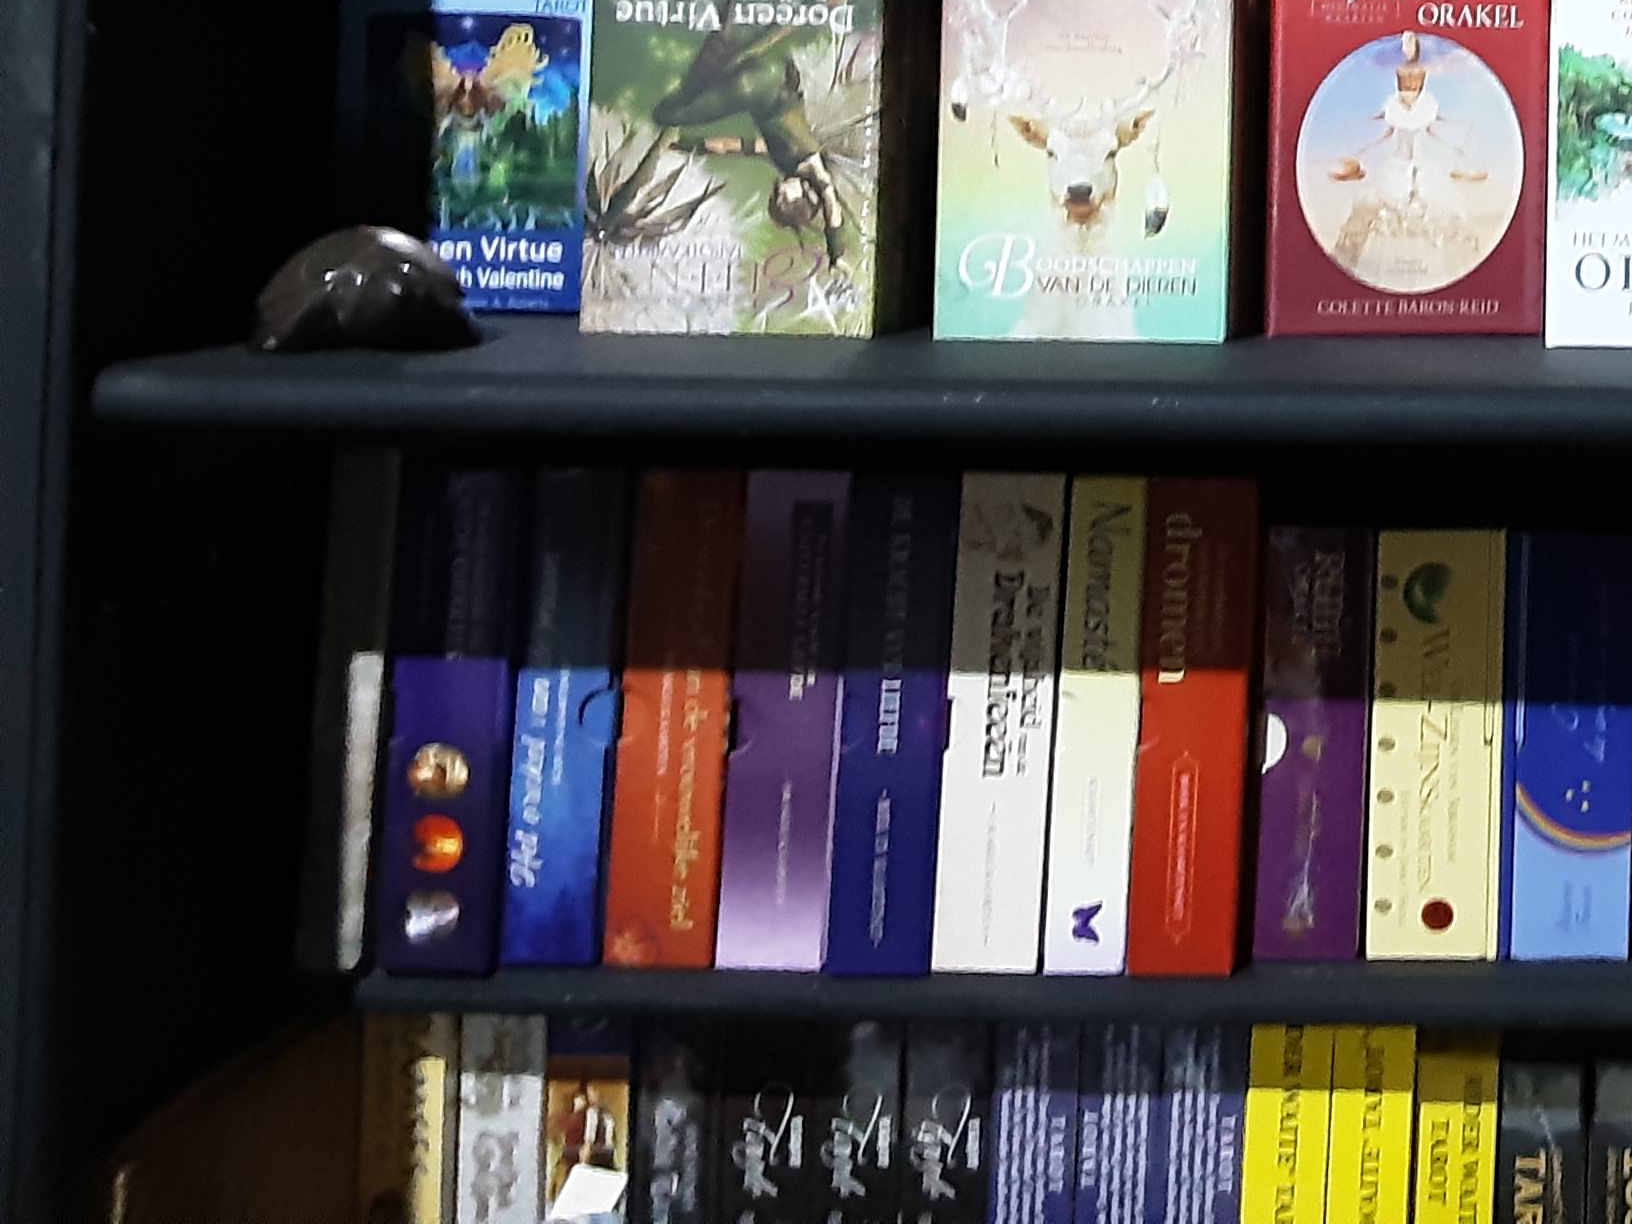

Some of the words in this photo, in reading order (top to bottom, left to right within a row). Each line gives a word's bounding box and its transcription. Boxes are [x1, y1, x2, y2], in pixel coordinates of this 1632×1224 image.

[615, 1, 723, 32] Virtue
[737, 2, 856, 34] Doreen
[1417, 2, 1525, 30] ORAKEL
[481, 235, 564, 264] Virtue
[476, 265, 566, 291] Valentine
[1035, 278, 1078, 297] VAN
[1124, 278, 1197, 298] DIEREN
[1316, 299, 1395, 317] COLETTE
[1156, 510, 1203, 686] dromen
